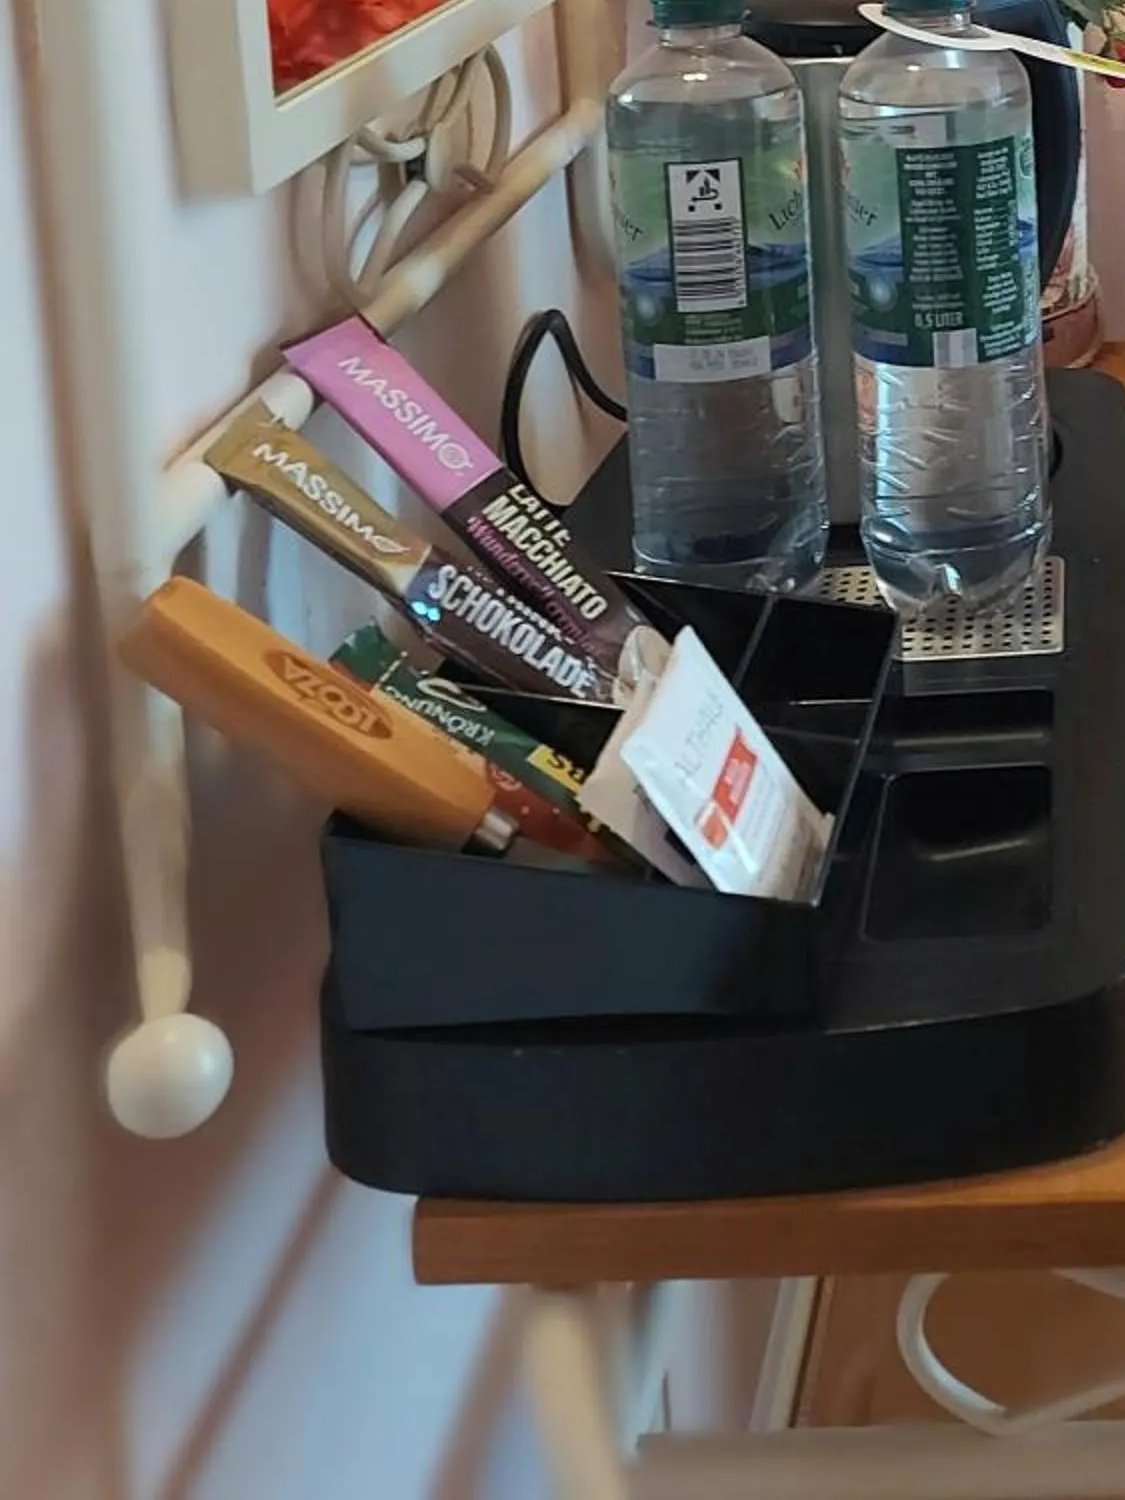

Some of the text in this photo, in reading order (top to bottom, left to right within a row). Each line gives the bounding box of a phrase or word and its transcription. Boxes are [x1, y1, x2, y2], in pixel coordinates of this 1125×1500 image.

[935, 311, 964, 328] LITER
[337, 354, 474, 478] MASSIMO
[252, 440, 411, 556] MASSIMO
[481, 494, 608, 621] MACCHIATO
[427, 564, 593, 698] SCHOKOLADE
